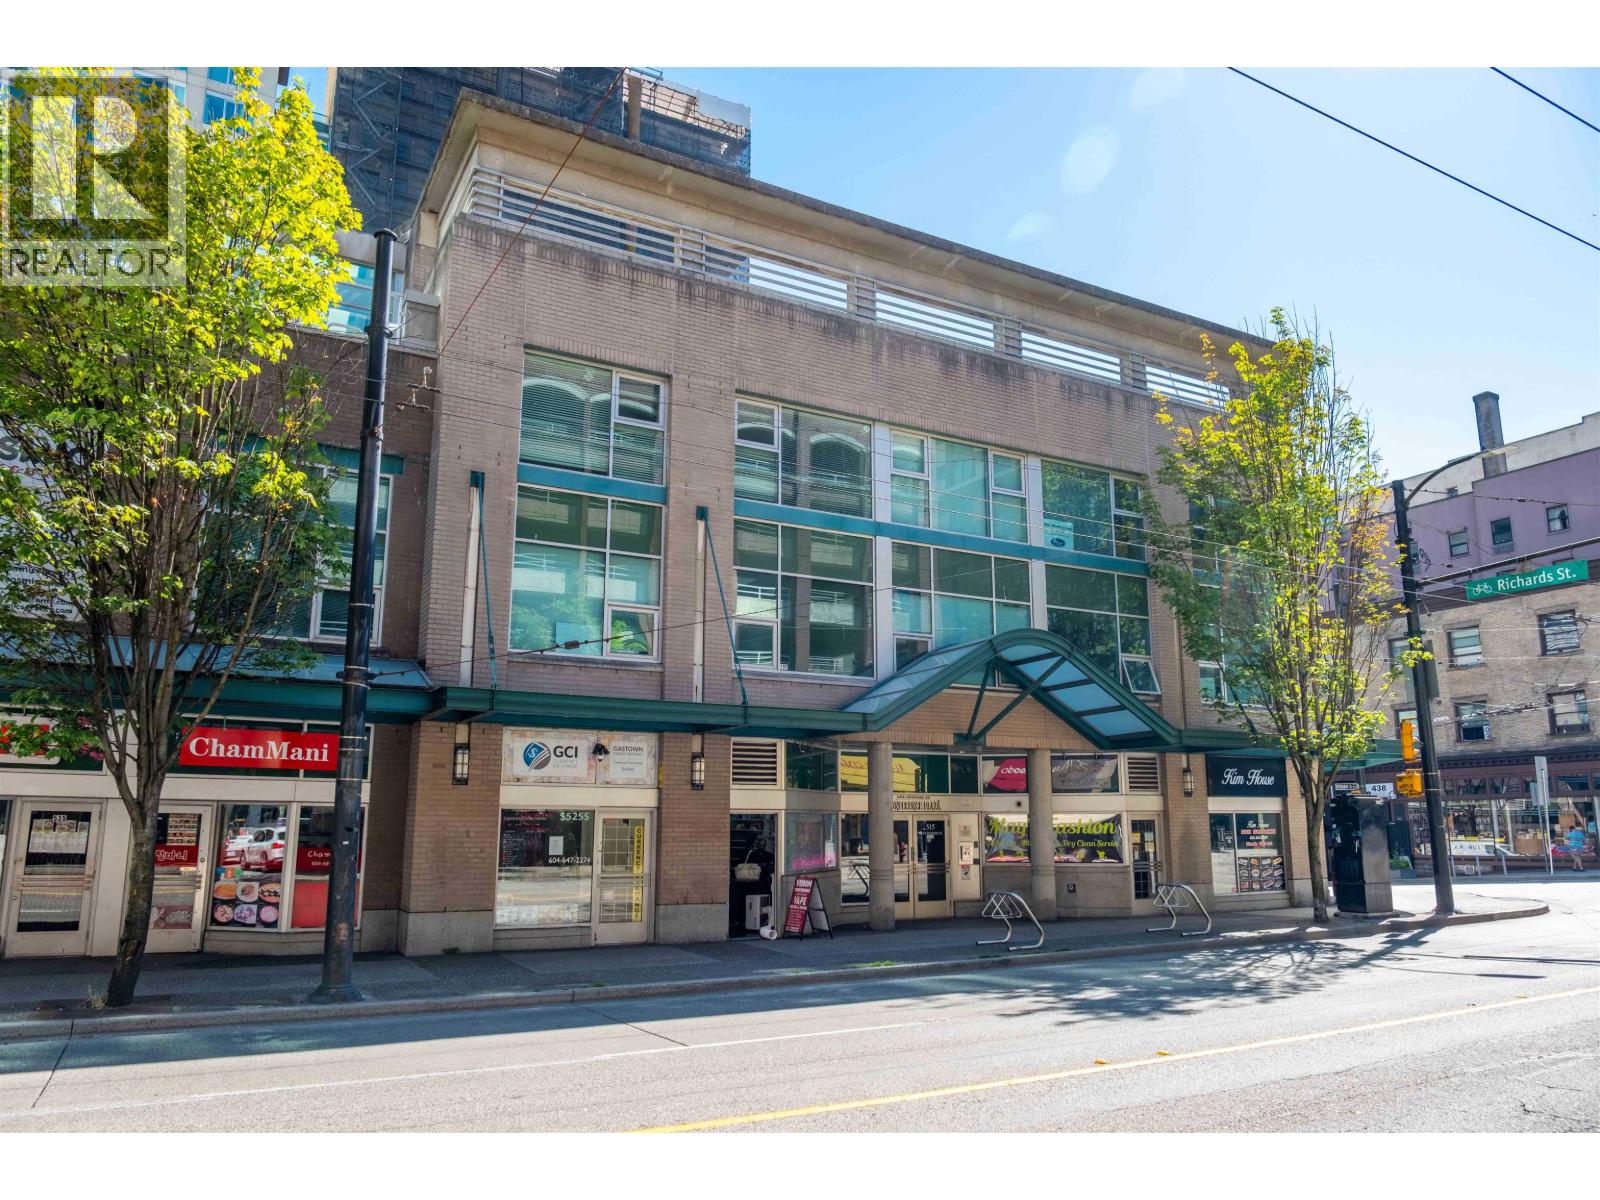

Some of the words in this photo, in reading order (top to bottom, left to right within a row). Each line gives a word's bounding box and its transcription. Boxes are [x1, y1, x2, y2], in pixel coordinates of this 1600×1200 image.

[1497, 570, 1554, 591] Richards
[1556, 567, 1577, 581] St.
[189, 737, 329, 762] ChamMani
[553, 745, 578, 758] GCI
[613, 745, 644, 753] GASTOWN
[1222, 768, 1245, 785] Kim
[1246, 769, 1275, 786] House
[1372, 784, 1387, 792] 438
[1063, 839, 1076, 848] Dry
